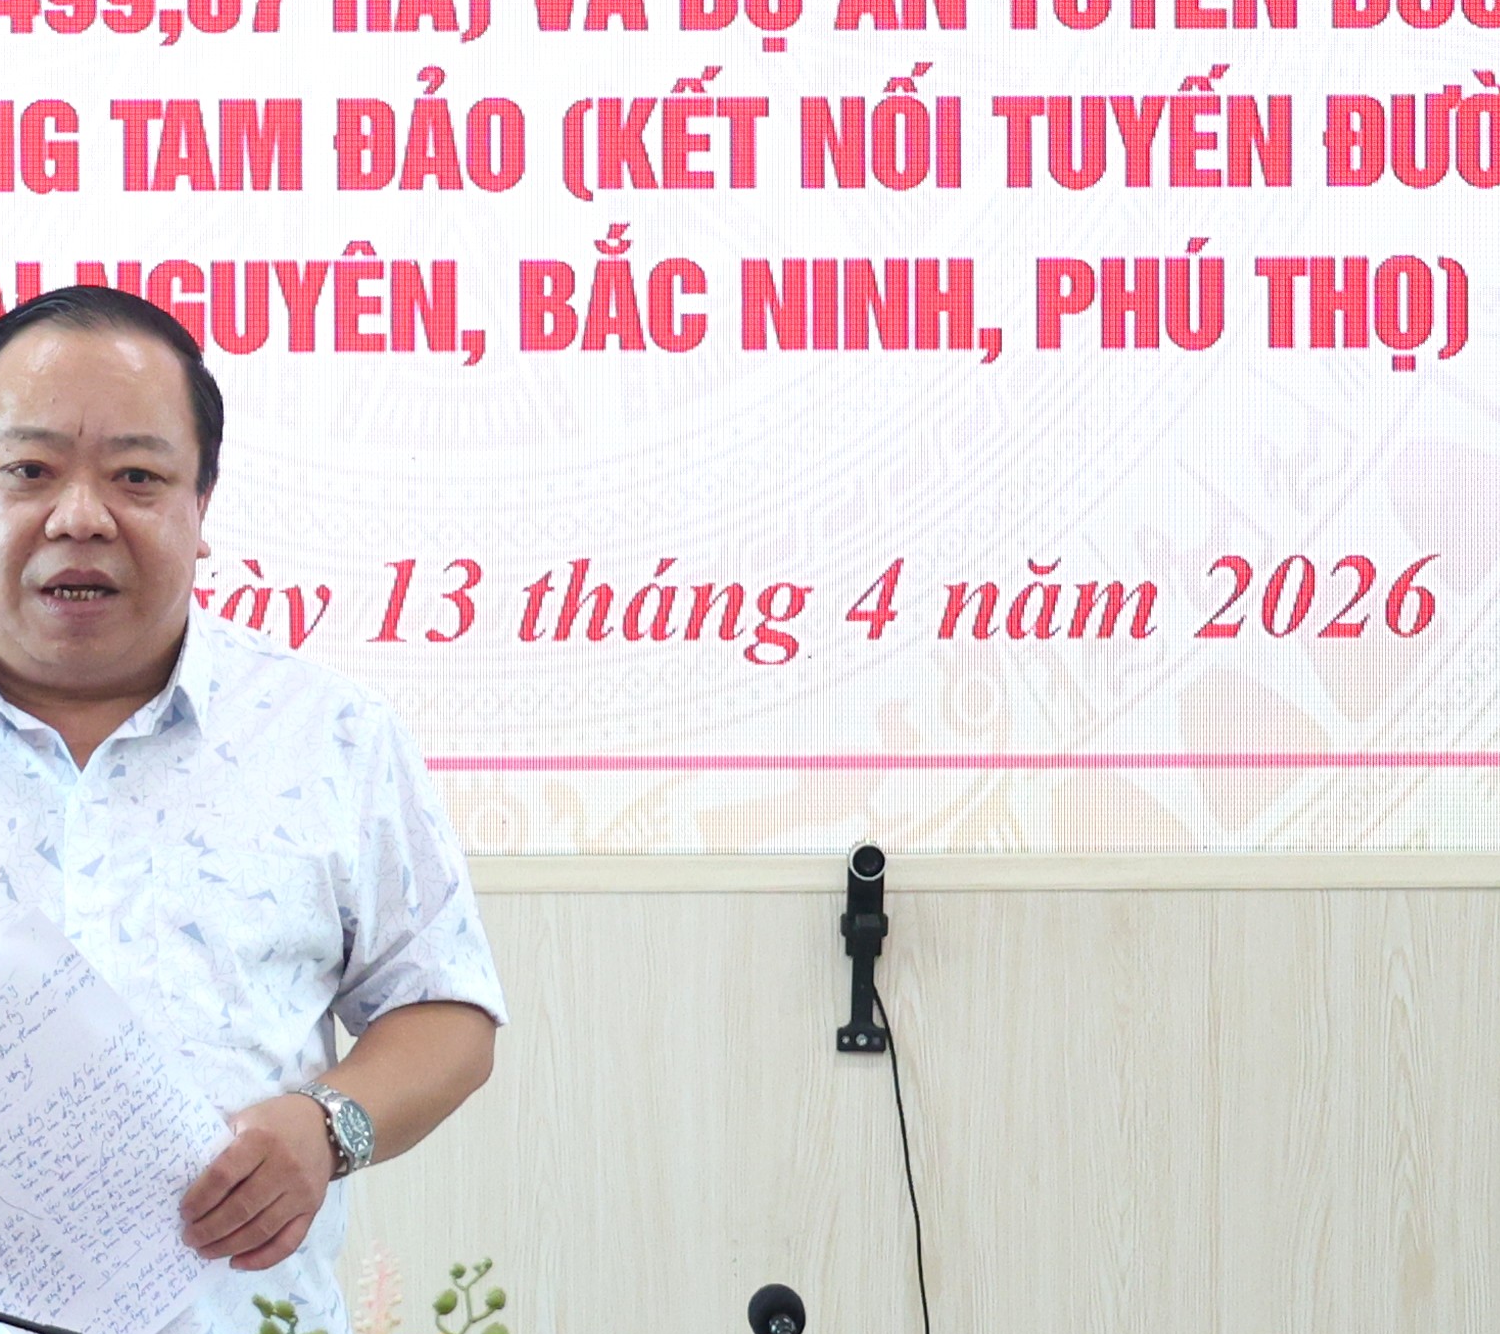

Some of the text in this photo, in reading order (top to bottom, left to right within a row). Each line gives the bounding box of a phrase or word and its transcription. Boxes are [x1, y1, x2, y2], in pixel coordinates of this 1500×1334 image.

[111, 99, 302, 191] TAM
[334, 66, 525, 193] ĐẢO
[564, 66, 768, 201] (KẾT
[801, 62, 961, 191] NỐI
[993, 64, 1292, 190] TUYẾN
[76, 241, 485, 366] GUYÊN,
[520, 223, 707, 353] BẮC
[741, 258, 1002, 363] NINH,
[1037, 237, 1224, 351] PHÚ
[1256, 255, 1468, 371] THỌ)
[193, 560, 332, 649] ày
[376, 559, 482, 642] 13
[519, 558, 812, 665] tháng
[847, 559, 903, 639] 4
[940, 563, 1157, 640] năm
[1197, 555, 1435, 638] 2026
